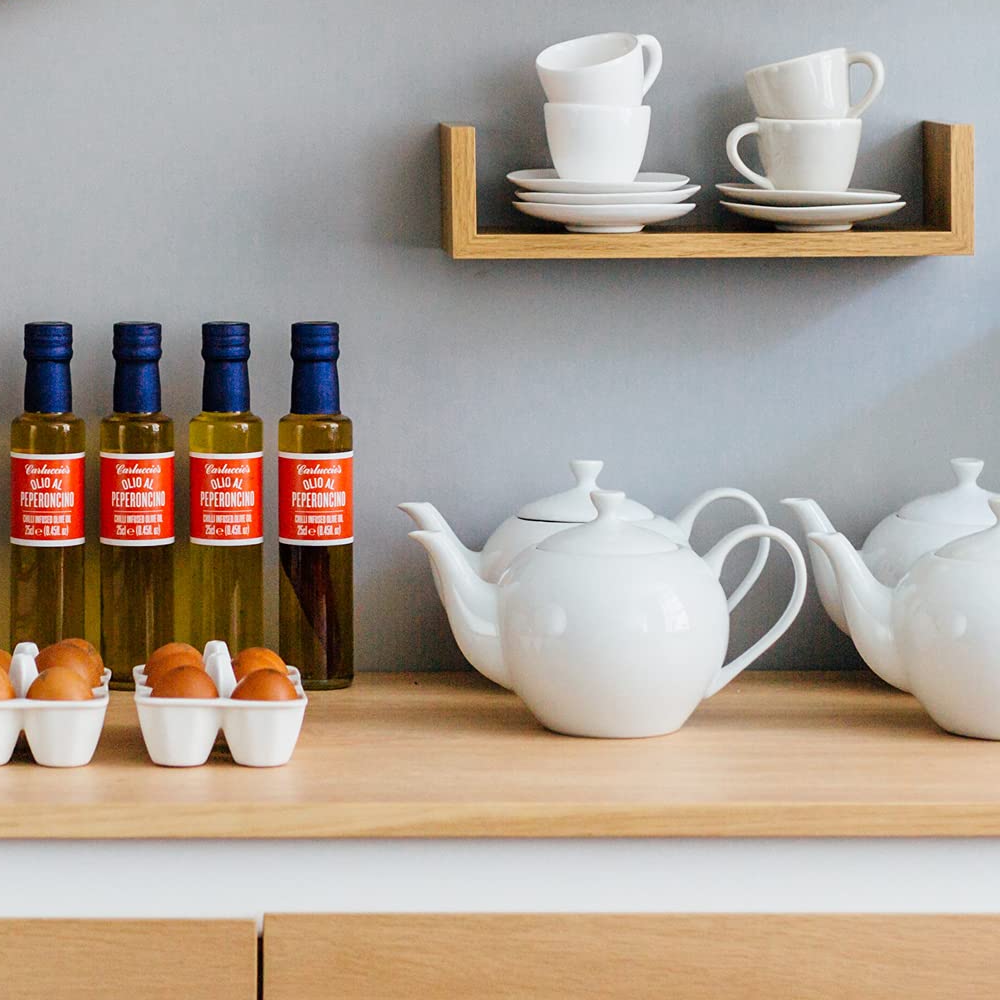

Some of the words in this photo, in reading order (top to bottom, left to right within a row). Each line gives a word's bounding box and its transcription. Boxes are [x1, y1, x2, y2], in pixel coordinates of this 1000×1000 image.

[25, 464, 71, 475] Carluccio's
[116, 463, 161, 475] Carluccio's
[205, 463, 250, 475] Carluccio's
[296, 464, 342, 475] Carluccio's
[30, 477, 50, 490] OLIO
[52, 478, 62, 490] AL
[121, 477, 142, 490] OLIO
[143, 478, 154, 490] AL
[210, 477, 231, 489] OLIO
[232, 478, 243, 490] AL
[302, 477, 323, 490] OLIO
[325, 478, 335, 490] AL
[21, 491, 74, 508] PEPERONCINO
[112, 491, 165, 507] PEPERONCINO
[200, 491, 255, 507] PEPERONCINO
[292, 491, 346, 508] PEPERONCINO
